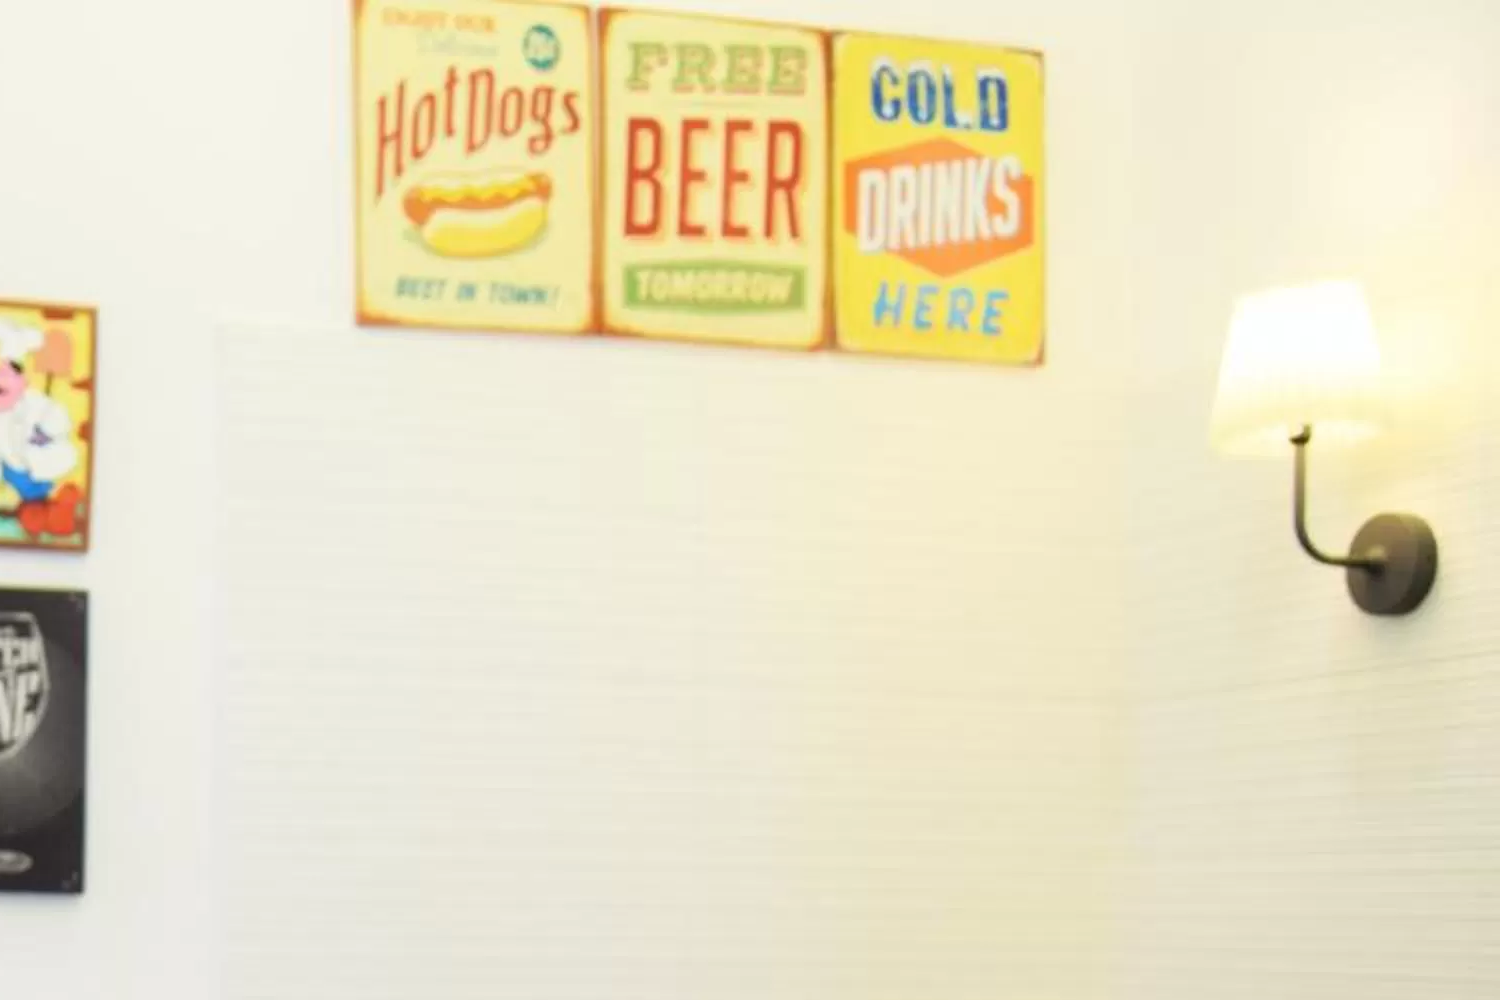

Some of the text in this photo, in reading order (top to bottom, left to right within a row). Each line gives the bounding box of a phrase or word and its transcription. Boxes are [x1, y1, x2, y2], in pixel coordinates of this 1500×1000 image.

[625, 41, 808, 96] FREE
[870, 55, 1009, 133] COLD
[623, 116, 805, 240] BEER
[855, 154, 1023, 256] DRINKS
[396, 275, 448, 299] BEST
[873, 280, 1010, 338] HERE
